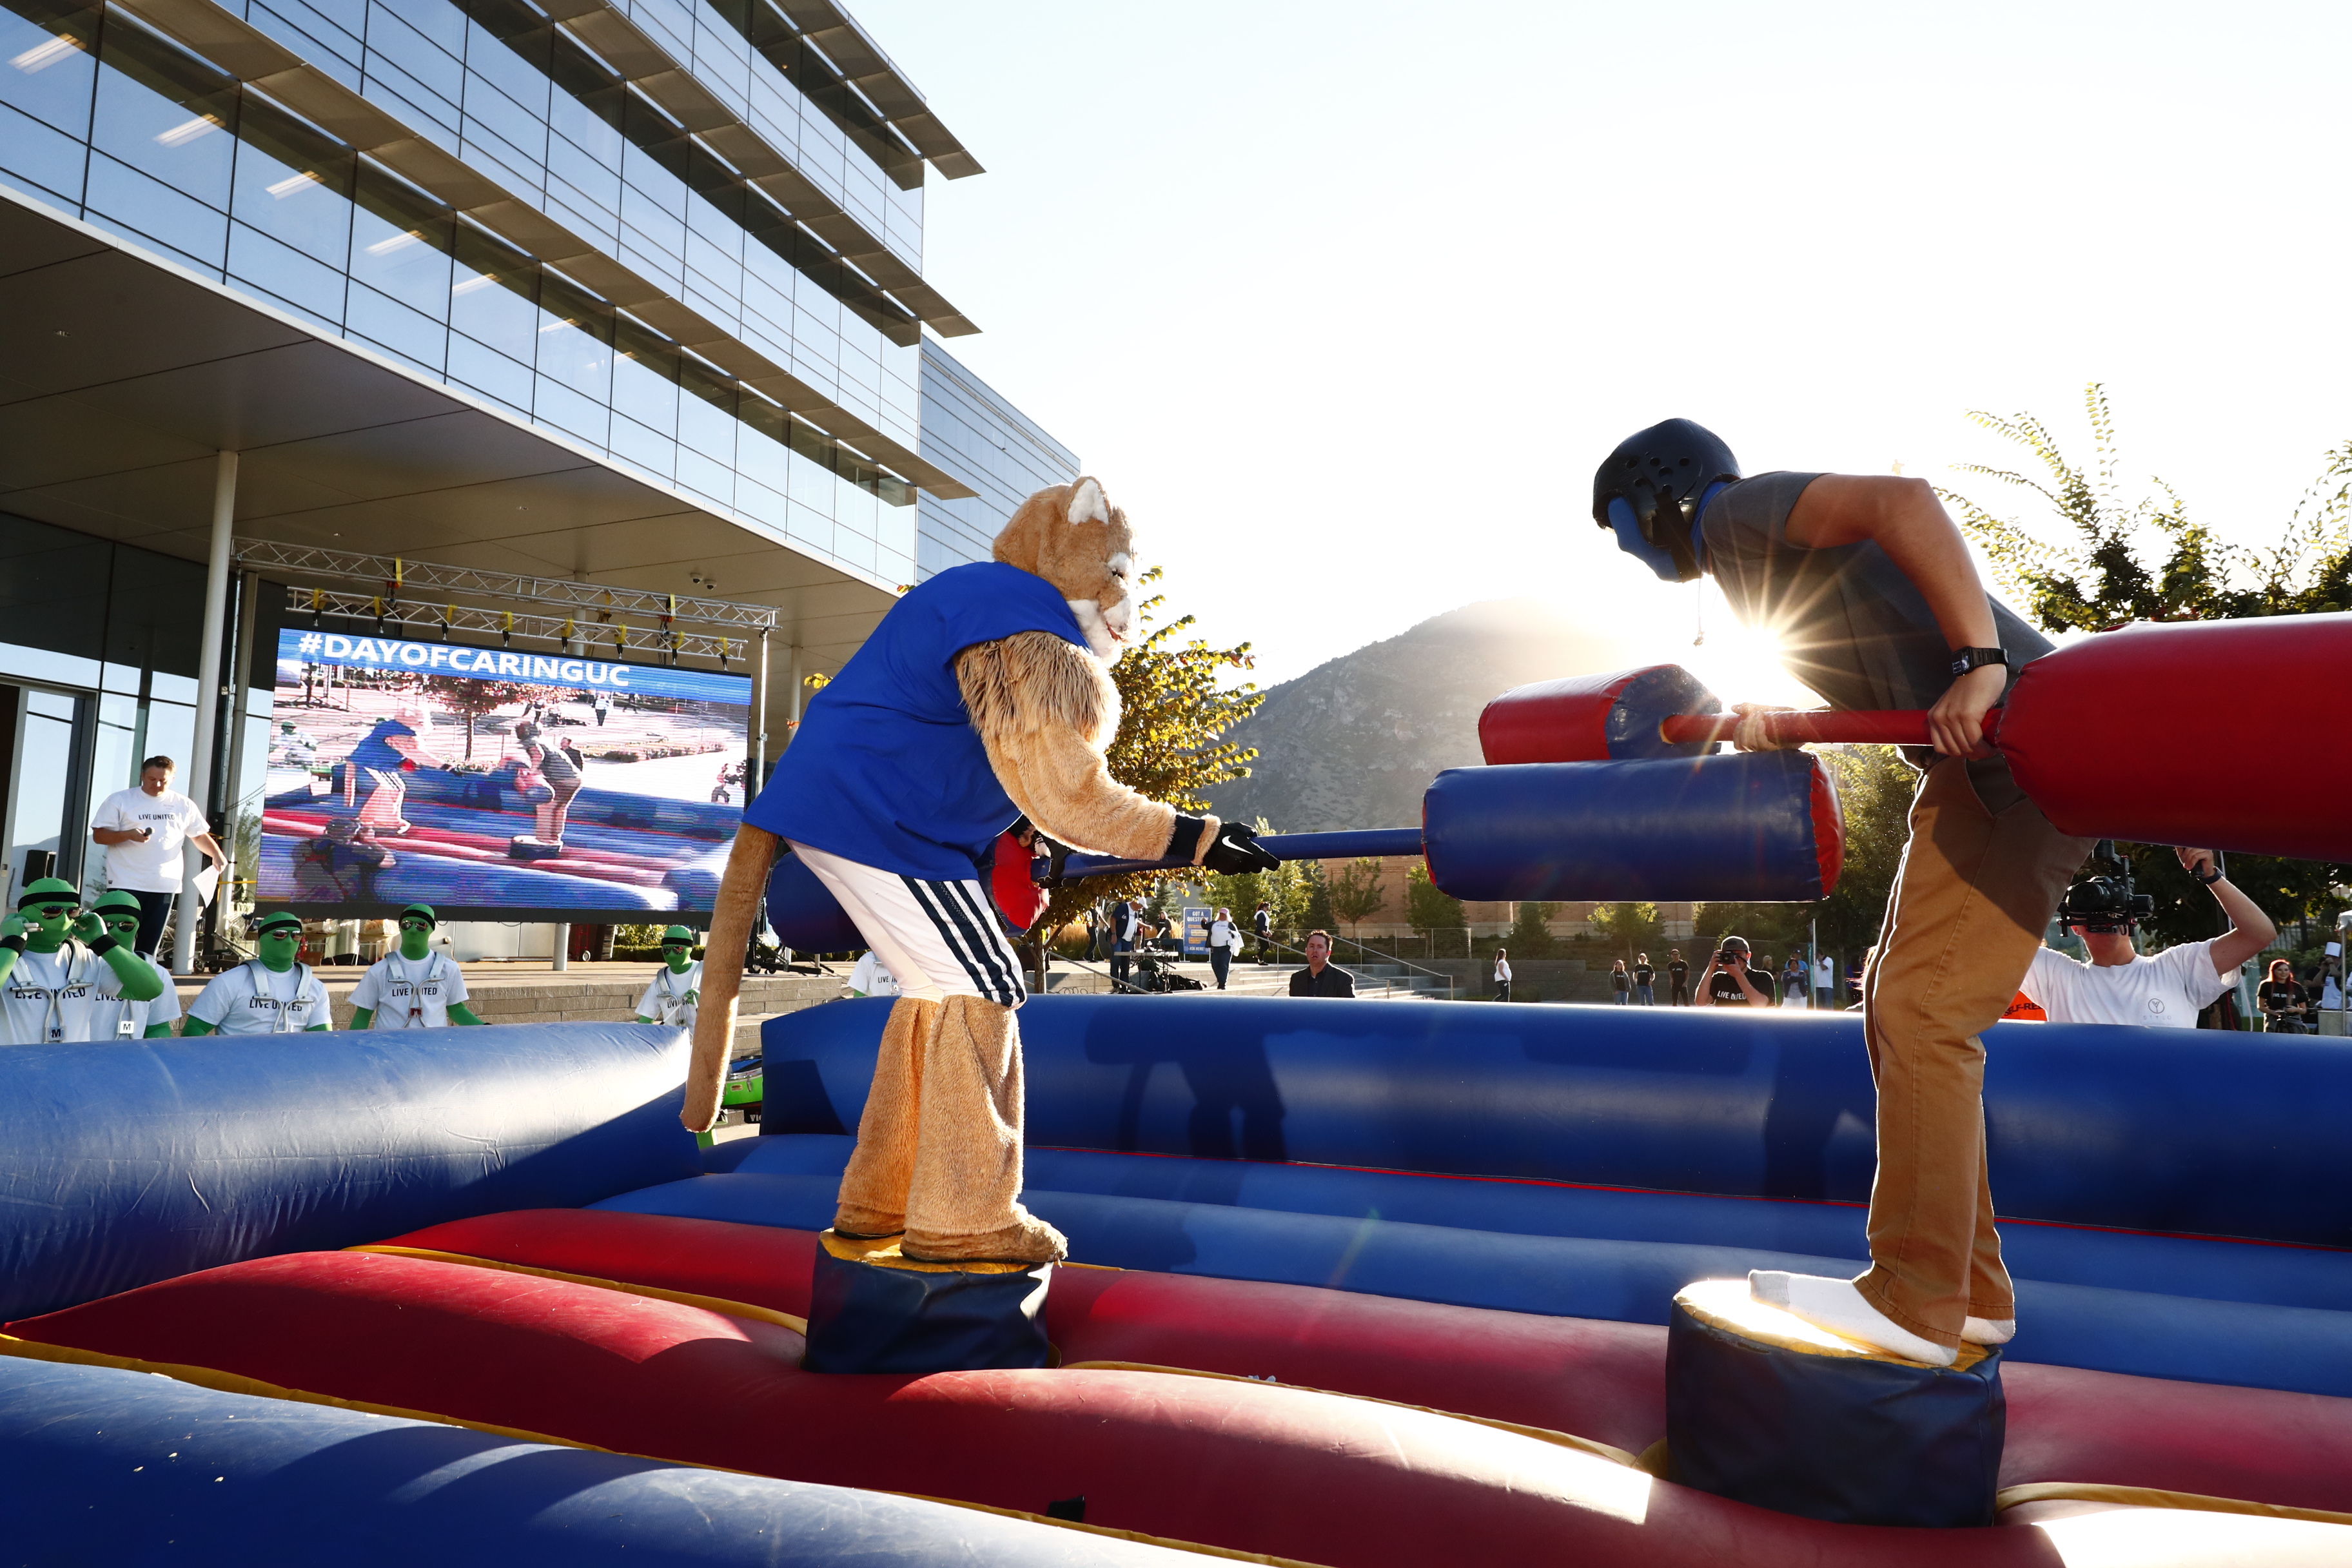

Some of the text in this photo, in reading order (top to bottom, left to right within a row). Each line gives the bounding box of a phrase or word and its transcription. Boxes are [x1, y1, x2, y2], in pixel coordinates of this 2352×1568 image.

[299, 632, 630, 687] #DAYOFCARINGUC
[392, 987, 437, 997] LIVE ITED
[250, 999, 269, 1009] LIVE
[52, 1029, 61, 1037] M
